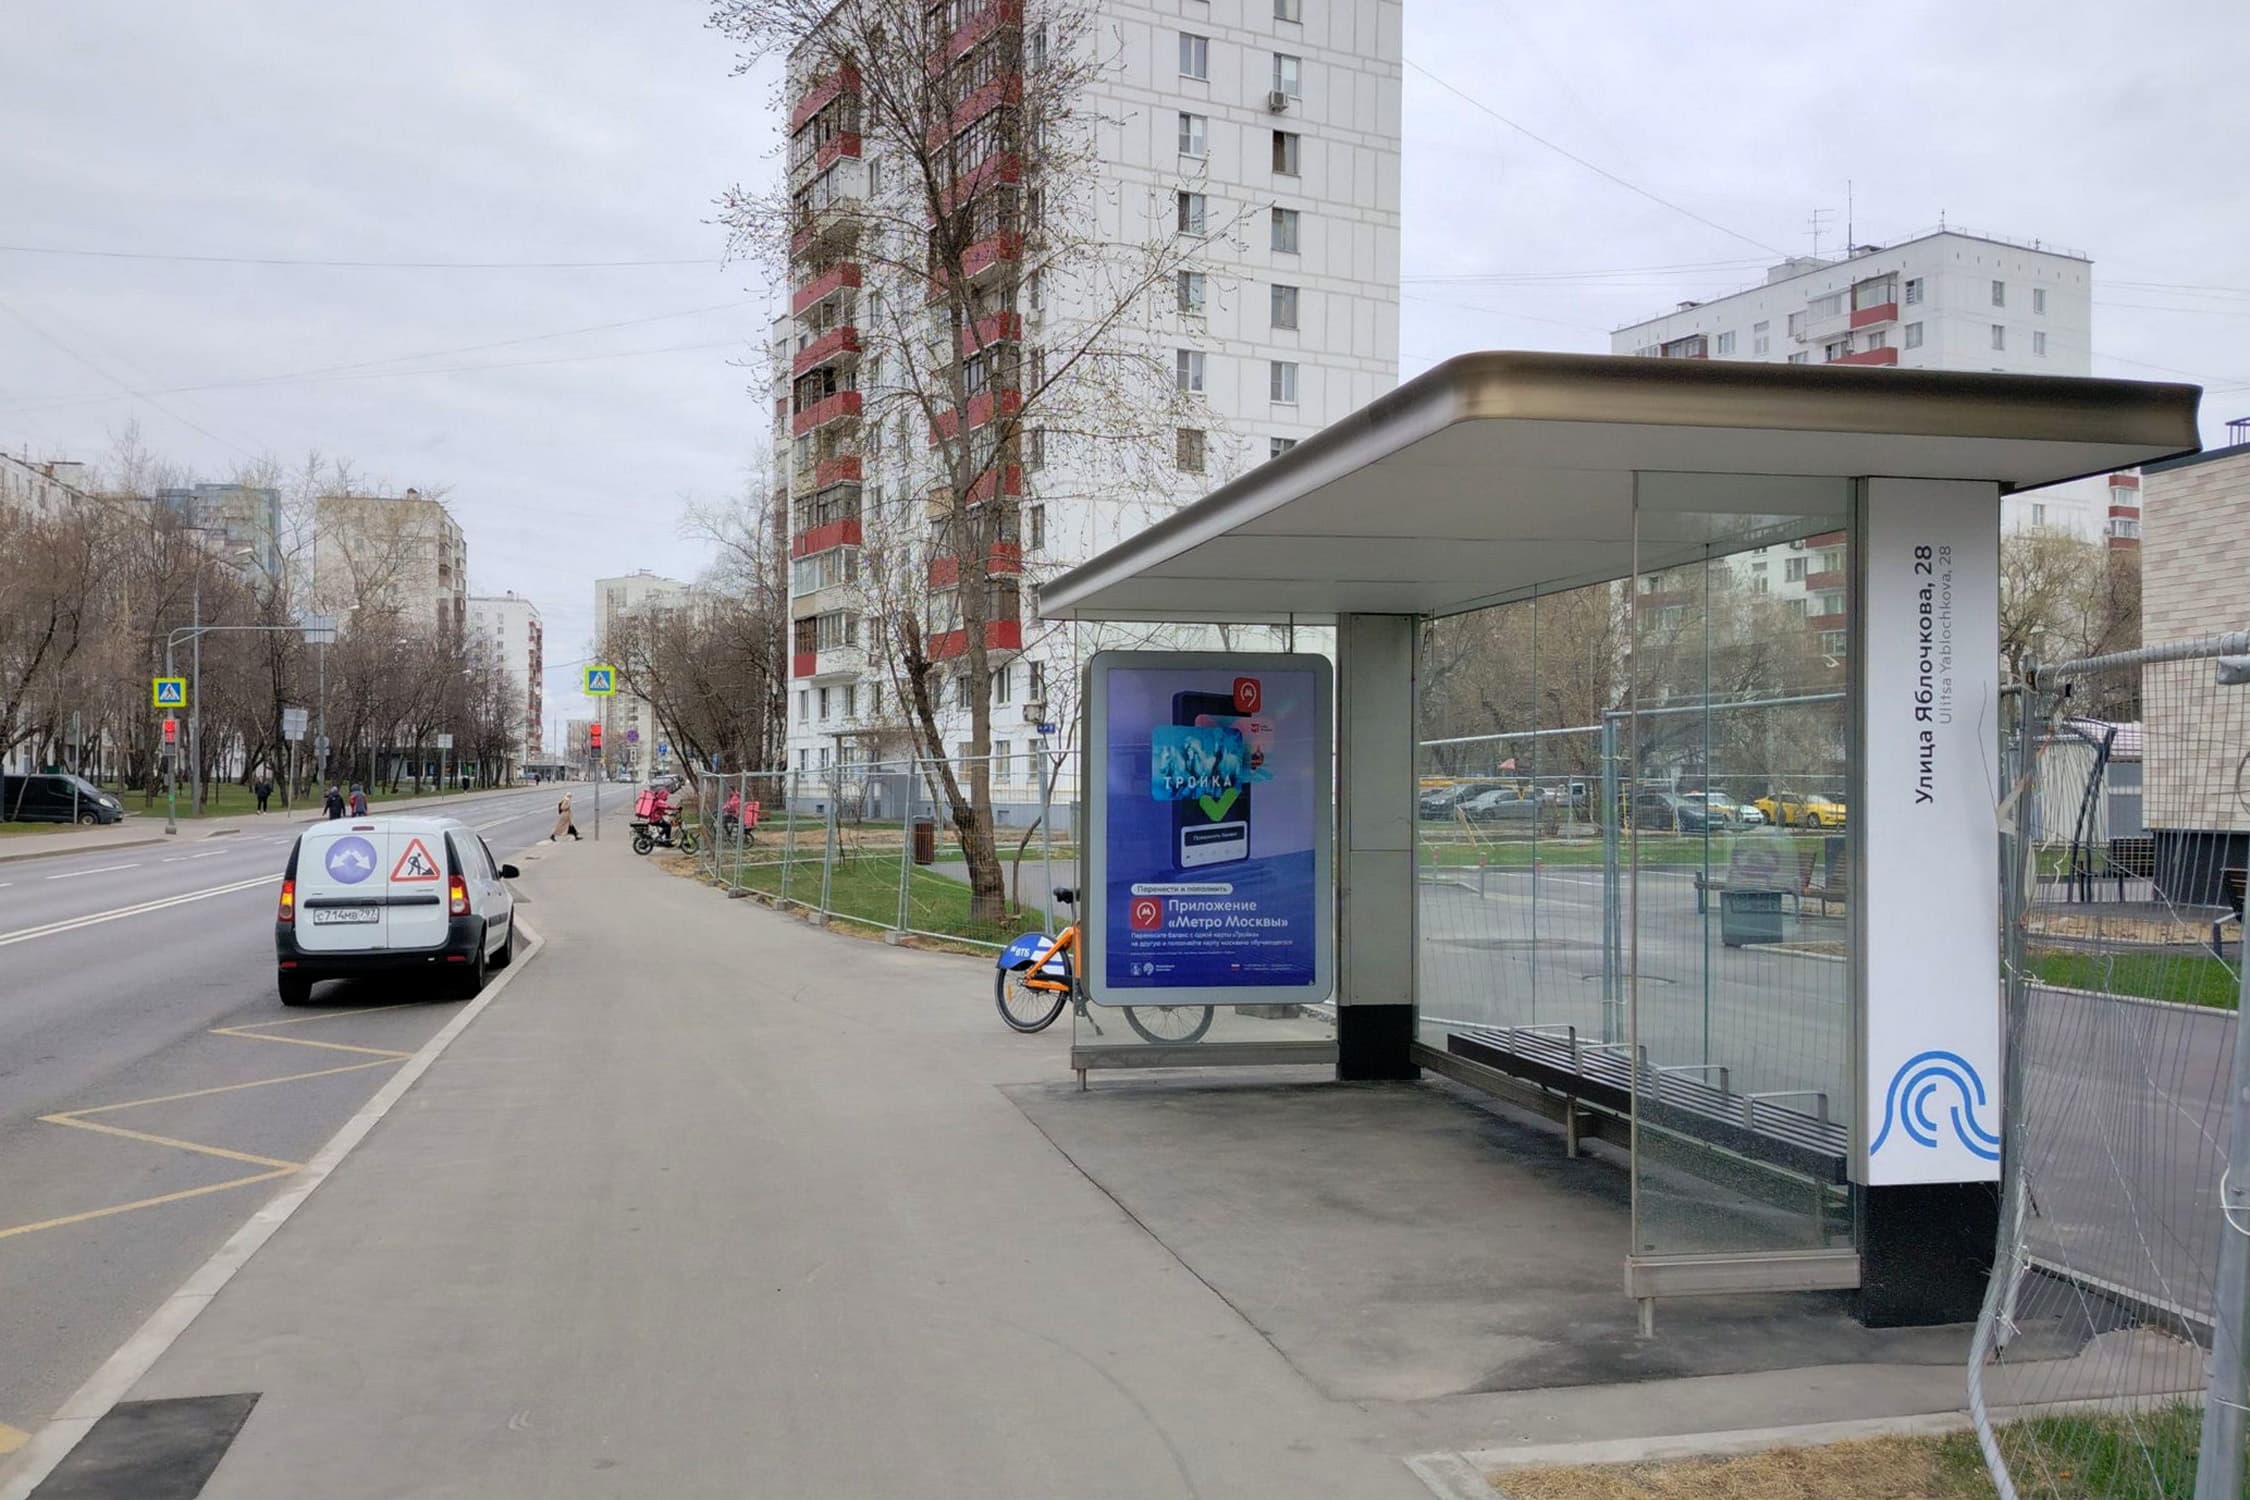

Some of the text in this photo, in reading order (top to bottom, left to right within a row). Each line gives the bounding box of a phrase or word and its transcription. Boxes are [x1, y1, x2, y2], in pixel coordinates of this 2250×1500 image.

[1938, 545, 1953, 725] Ulitsa Yablochkova, 28
[1914, 545, 1937, 805] Улица Яблочкова, 28
[1136, 885, 1178, 895] Перенести
[1168, 899, 1257, 912] Приложение
[1168, 915, 1288, 929] «Метро Москвы»
